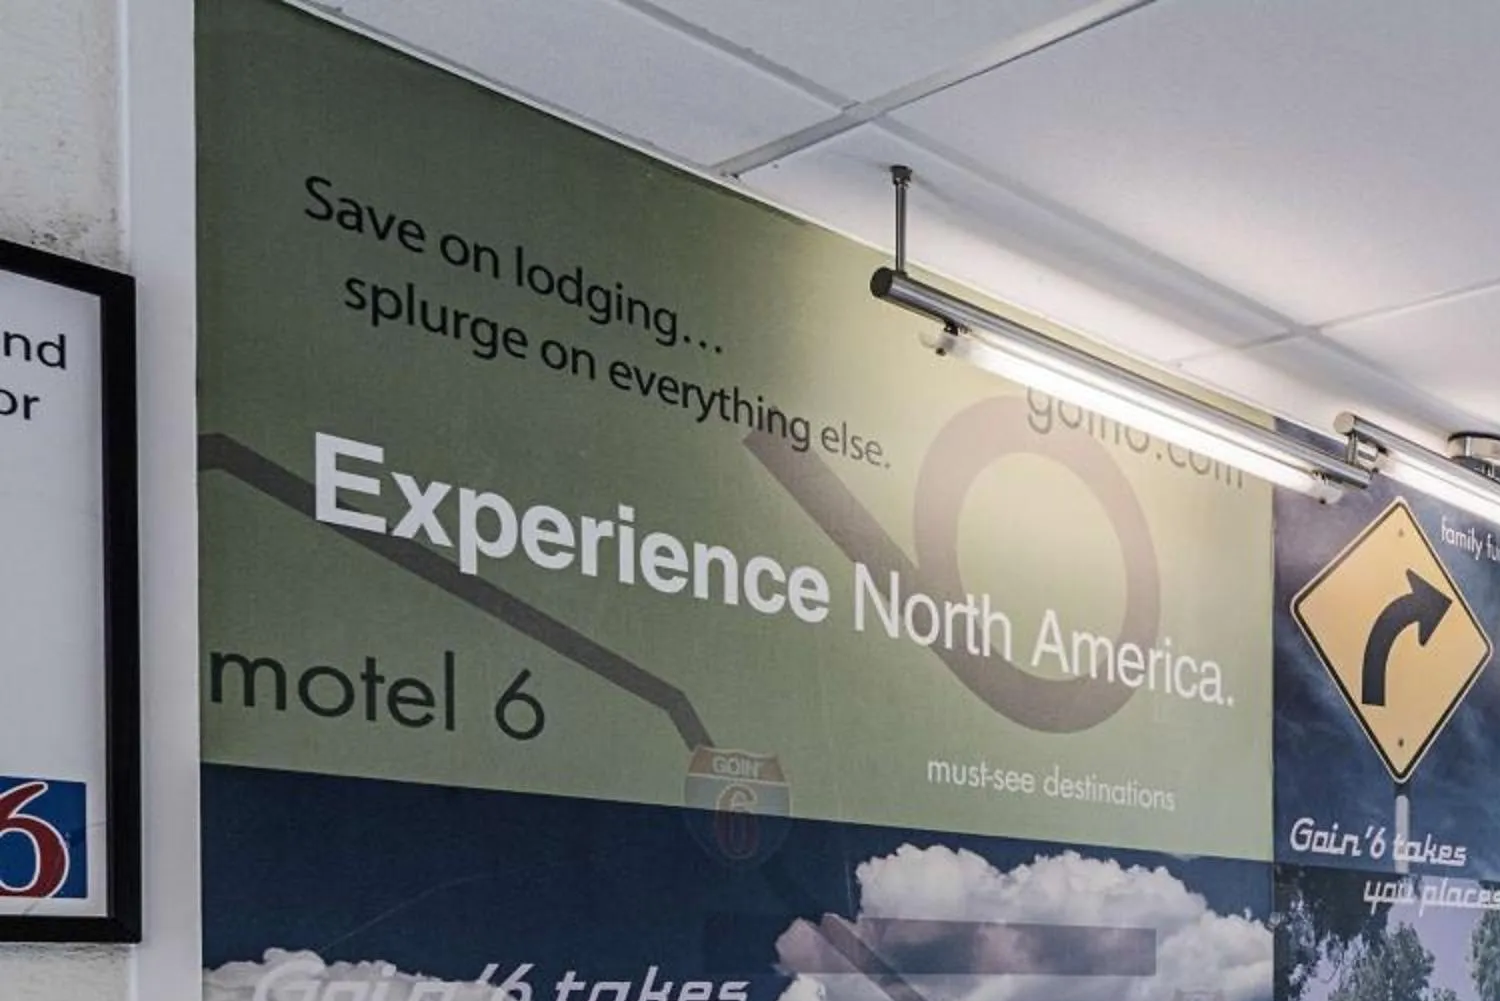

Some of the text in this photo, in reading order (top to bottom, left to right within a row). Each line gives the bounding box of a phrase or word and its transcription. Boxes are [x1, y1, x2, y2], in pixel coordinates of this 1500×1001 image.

[305, 175, 723, 353] Save on lodging...
[344, 276, 891, 469] splurge on everything else.
[314, 431, 1235, 706] Experience North America.
[1440, 515, 1484, 561] family
[209, 650, 546, 741] motel 6
[927, 757, 1176, 812] must-see destinations
[1393, 833, 1468, 867] takes
[1364, 878, 1414, 917] you
